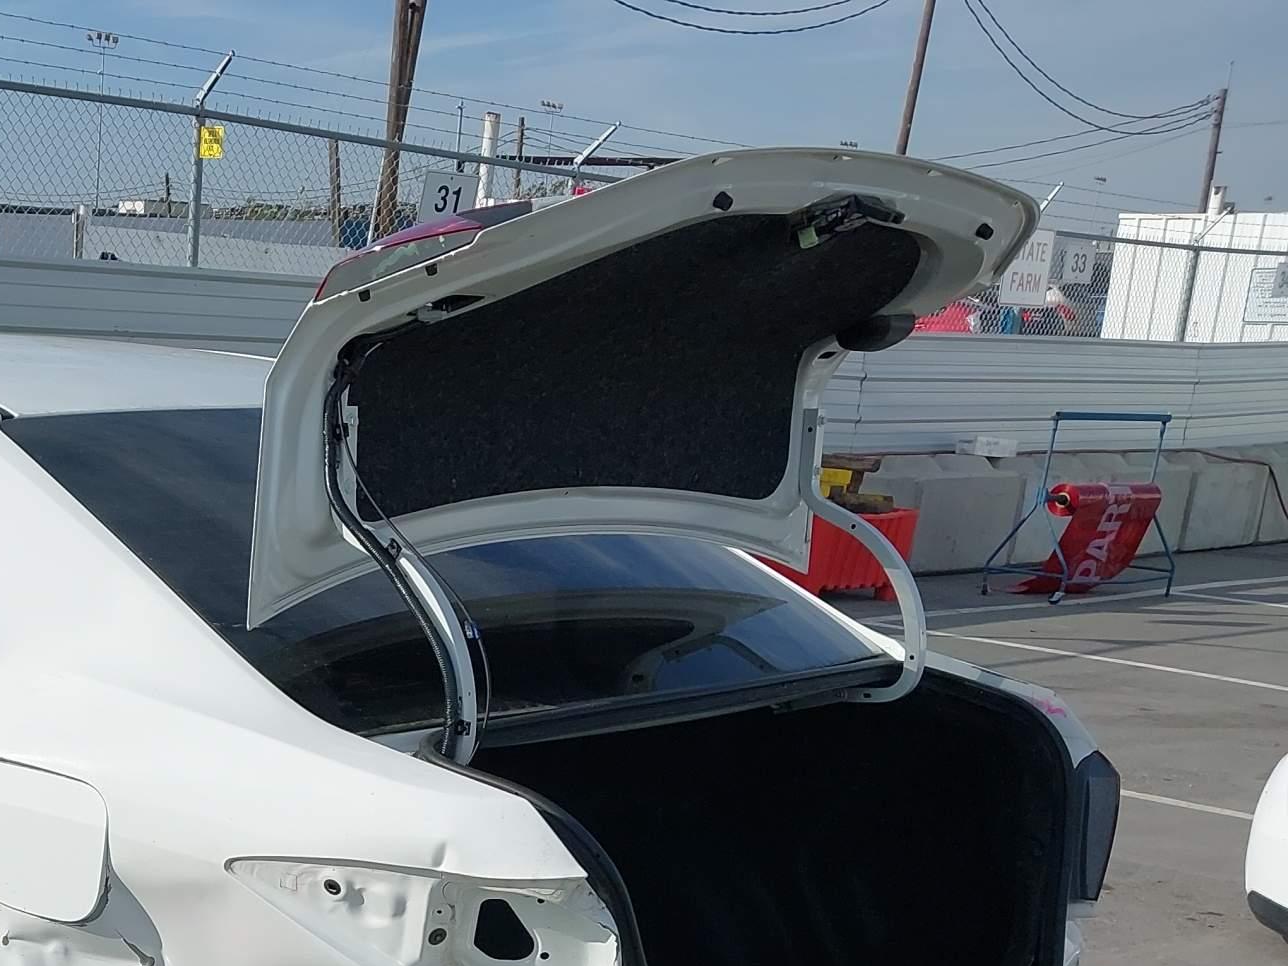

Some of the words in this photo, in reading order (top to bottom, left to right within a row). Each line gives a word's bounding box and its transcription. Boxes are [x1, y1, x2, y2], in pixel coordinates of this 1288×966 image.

[434, 184, 462, 214] 31
[1015, 240, 1049, 263] TATE
[1071, 252, 1088, 274] 33
[1009, 271, 1042, 294] FARM
